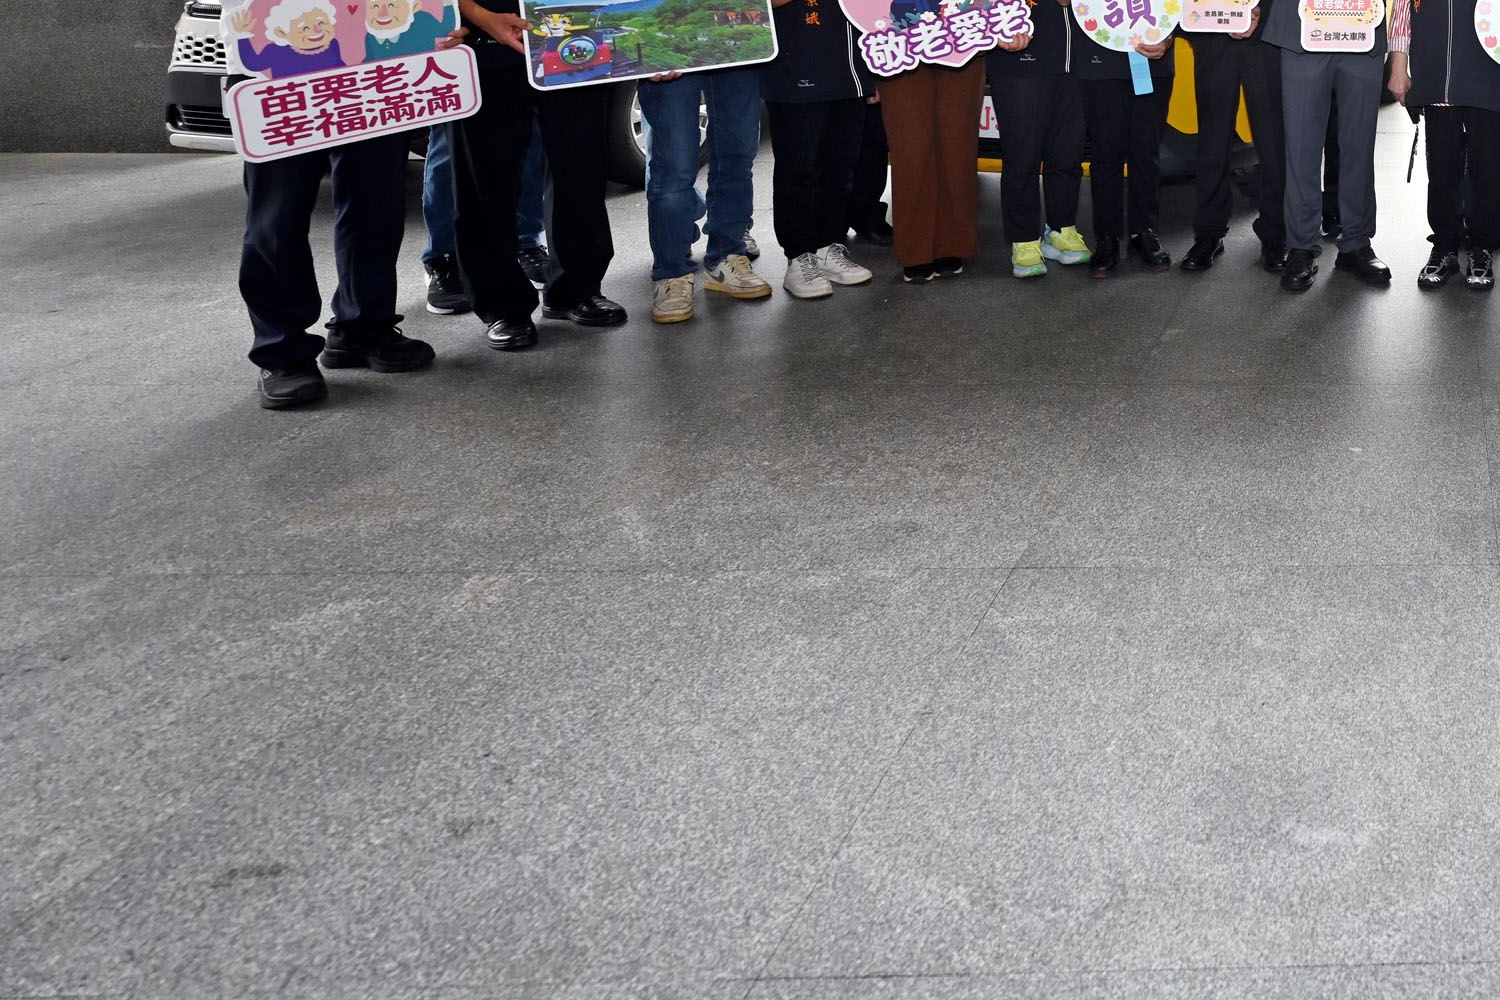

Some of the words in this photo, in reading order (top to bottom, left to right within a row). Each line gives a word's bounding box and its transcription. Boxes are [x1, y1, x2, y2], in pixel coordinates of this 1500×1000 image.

[866, 1, 1028, 70] 敬老愛老
[1313, 0, 1366, 9] 敬老愛心卡
[1323, 31, 1367, 41] 台灣大車隊
[253, 56, 458, 118] 苗栗老人
[260, 83, 462, 146] 幸福滿滿
